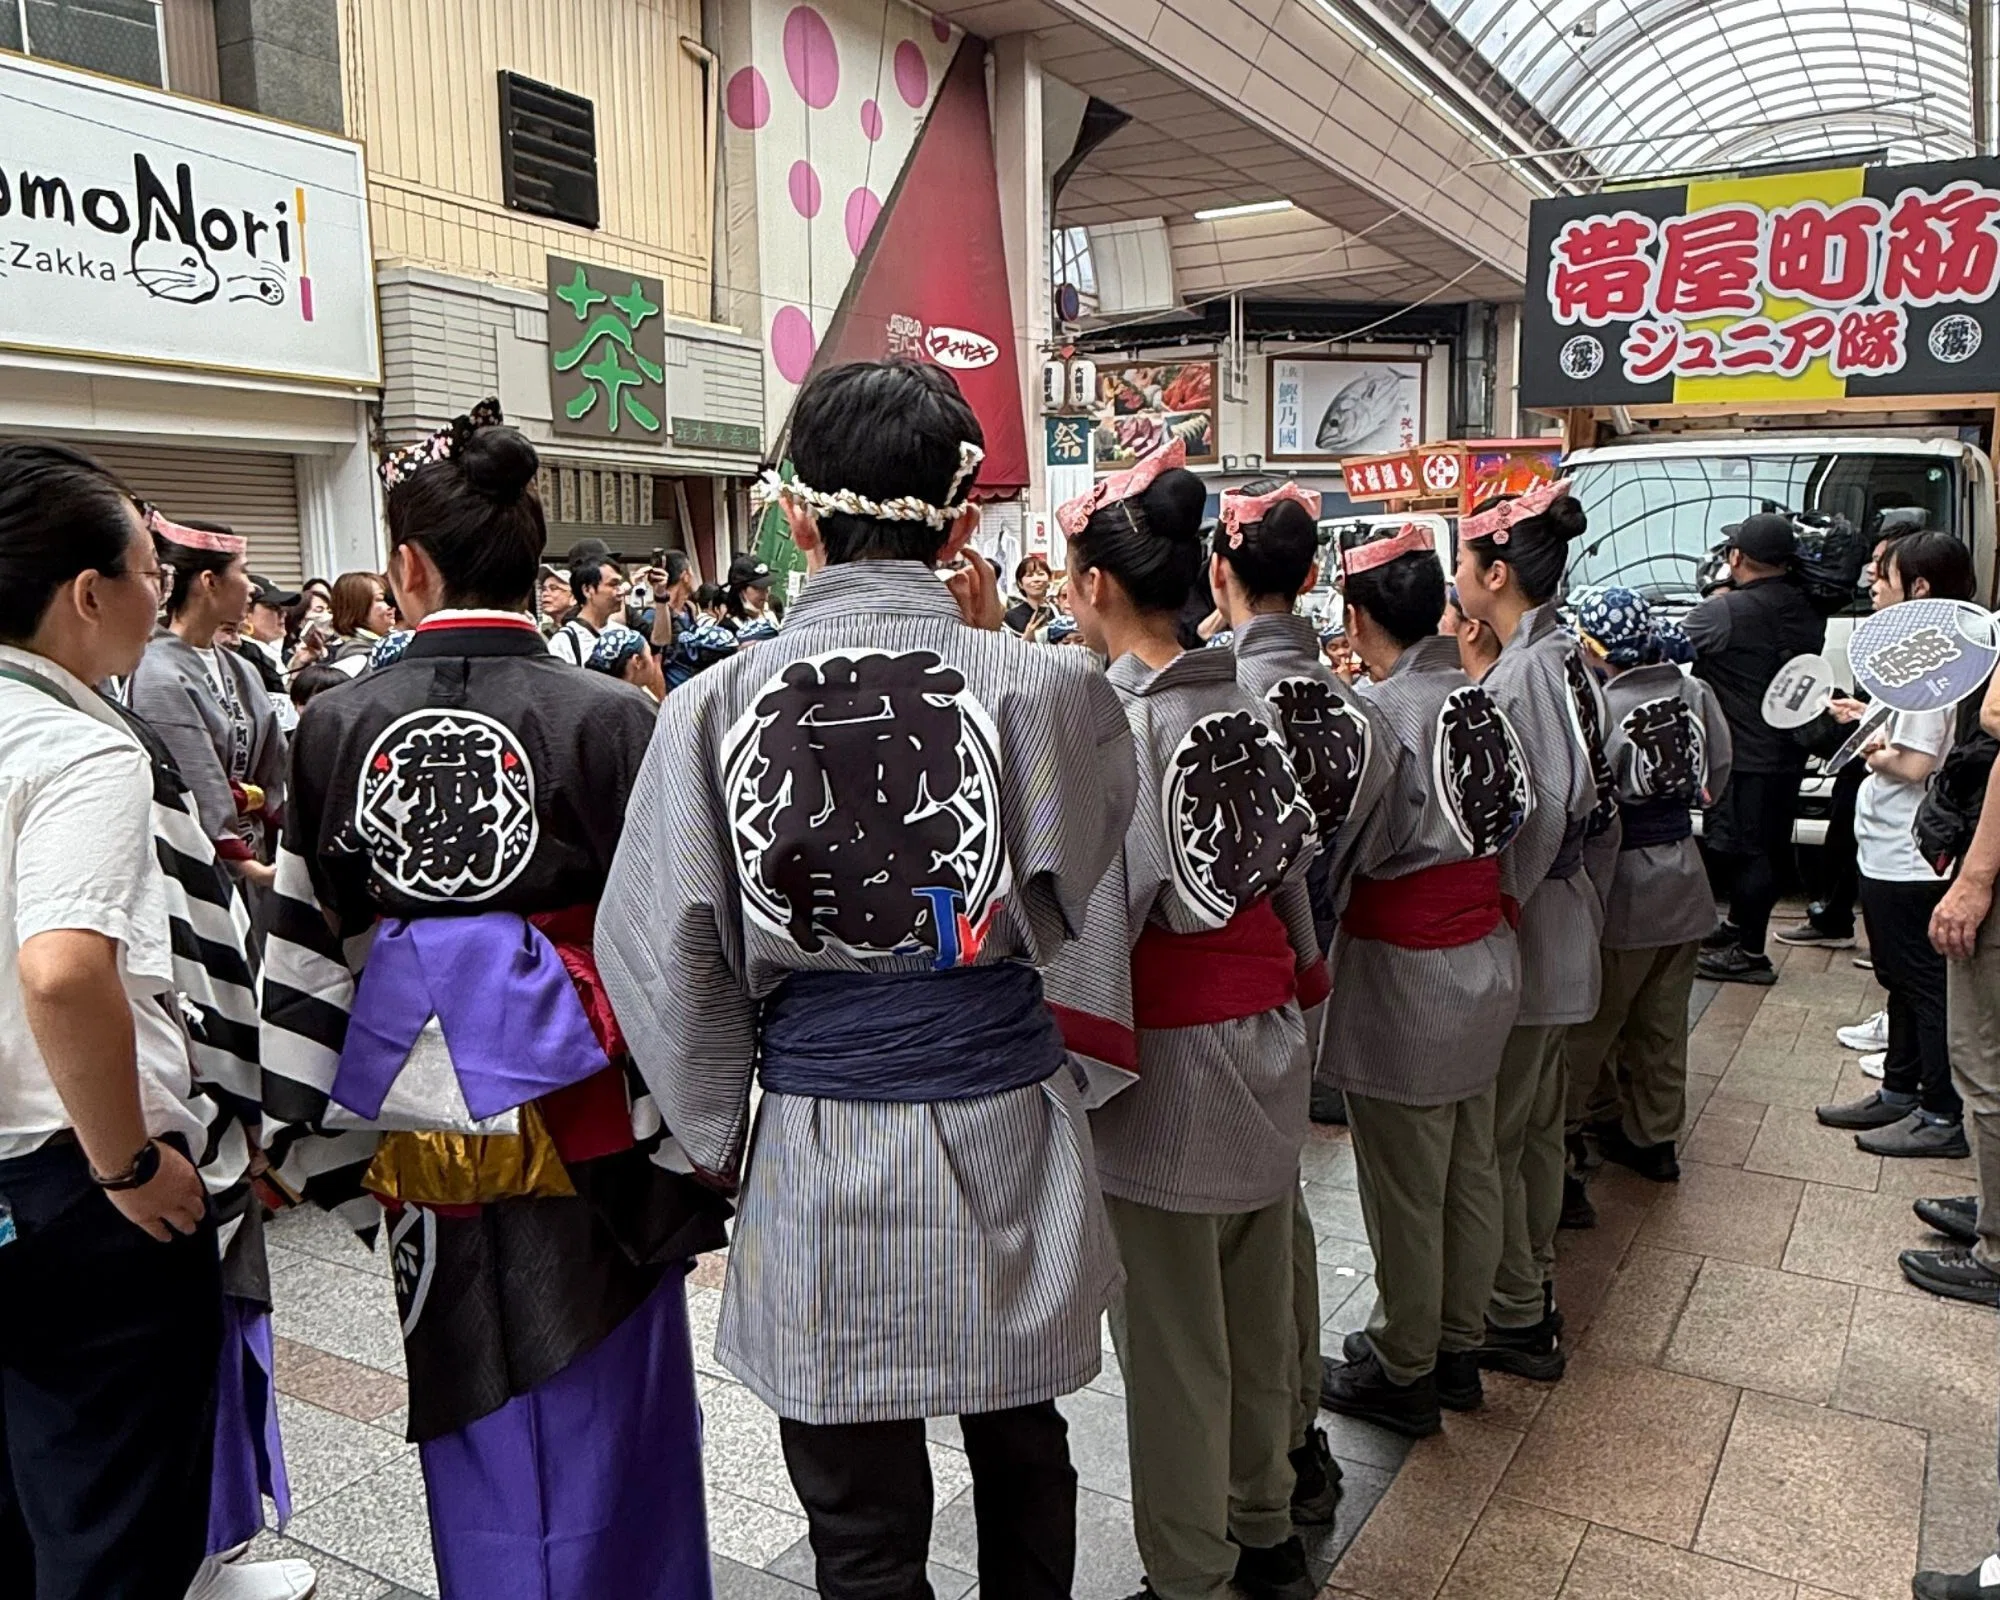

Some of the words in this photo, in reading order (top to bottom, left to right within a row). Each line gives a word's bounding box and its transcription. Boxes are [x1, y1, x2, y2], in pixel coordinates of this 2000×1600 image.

[10, 240, 116, 282] Zakka
[1551, 186, 2000, 320] 帯屋町筋
[553, 264, 664, 433] 茶
[1626, 309, 1899, 378] ジュニア隊
[1050, 422, 1085, 459] 祭
